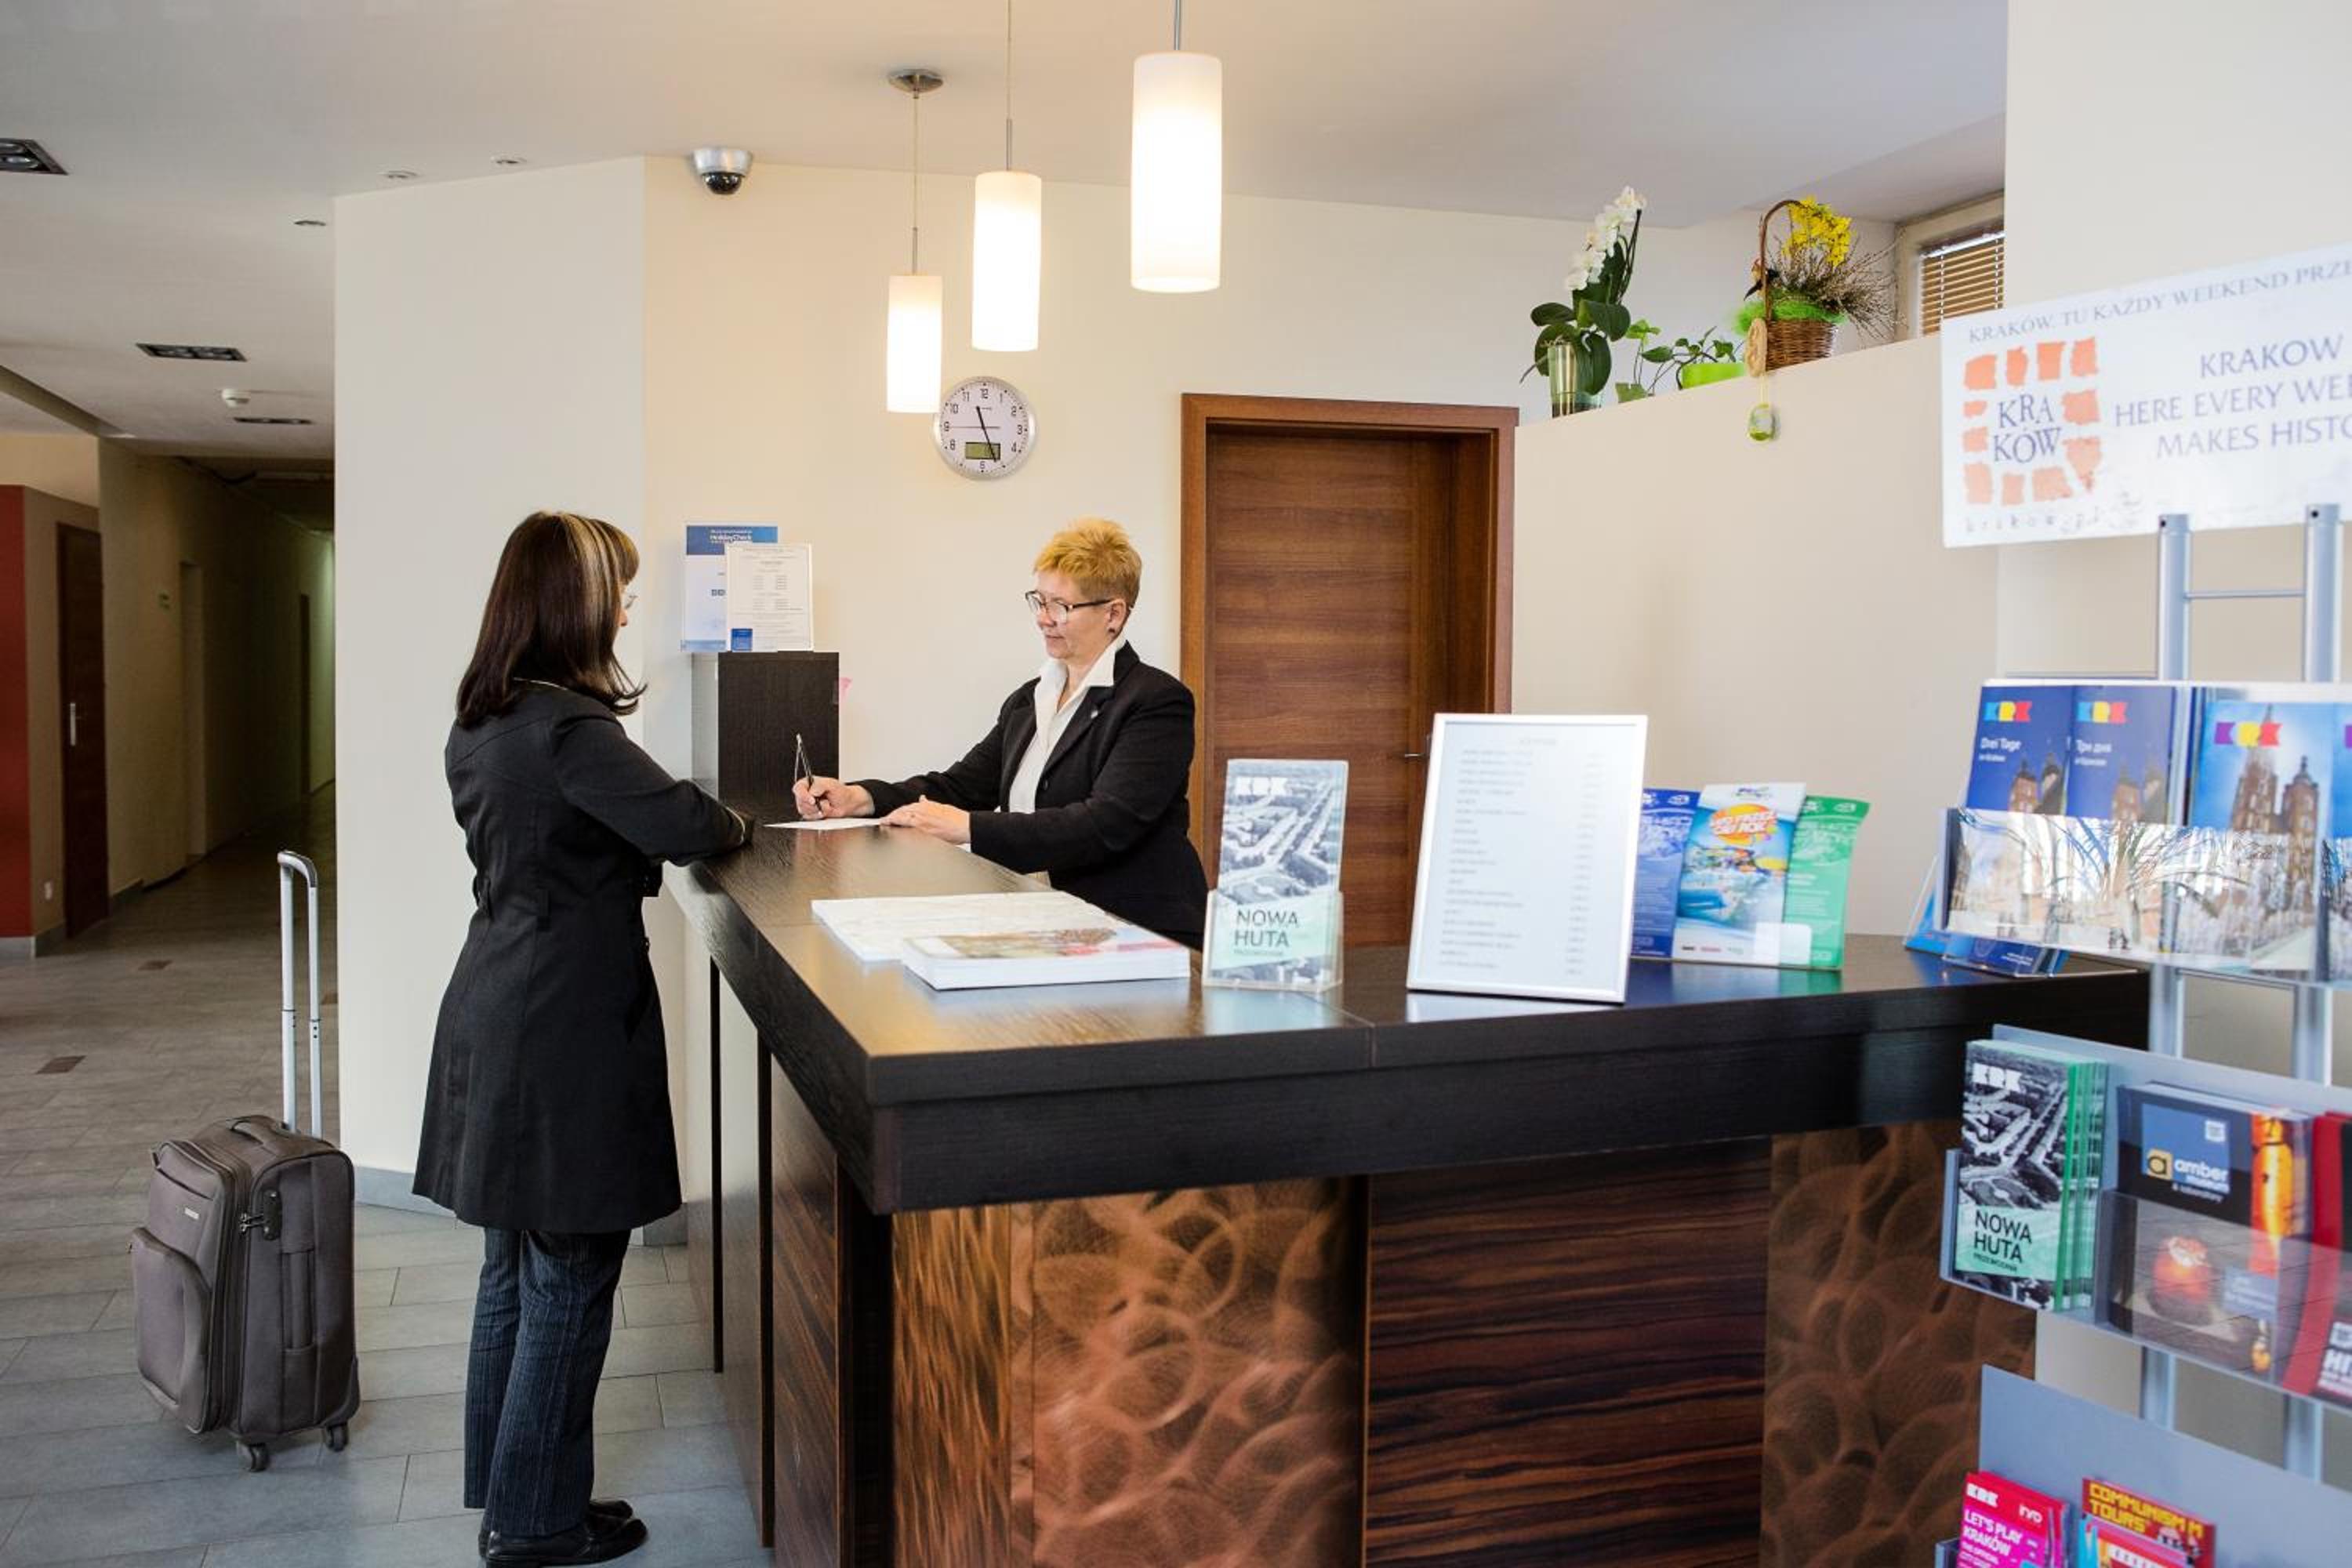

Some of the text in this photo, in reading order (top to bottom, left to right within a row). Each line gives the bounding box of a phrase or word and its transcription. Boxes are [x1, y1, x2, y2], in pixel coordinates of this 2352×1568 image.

[2062, 309, 2087, 327] TU
[2172, 271, 2288, 305] WEEKEND
[2201, 334, 2343, 378] KRAKOW
[980, 388, 989, 399] 12
[2115, 396, 2183, 427] HERE
[2195, 382, 2283, 417] EVERY
[1011, 405, 1017, 416] 2
[1998, 394, 2054, 428] KRA
[1017, 424, 1022, 435] 3
[2157, 423, 2259, 459] MAKES
[949, 439, 956, 451] 8
[1011, 442, 1017, 452] 4
[1236, 909, 1300, 927] NOWA
[1234, 930, 1290, 947] HUTA
[2174, 1158, 2229, 1183] amber
[1975, 1210, 2032, 1244] NOWA
[1974, 1231, 2023, 1264] HUTA
[2089, 1498, 2146, 1534] TOURS
[1994, 1522, 2023, 1544] PLAY
